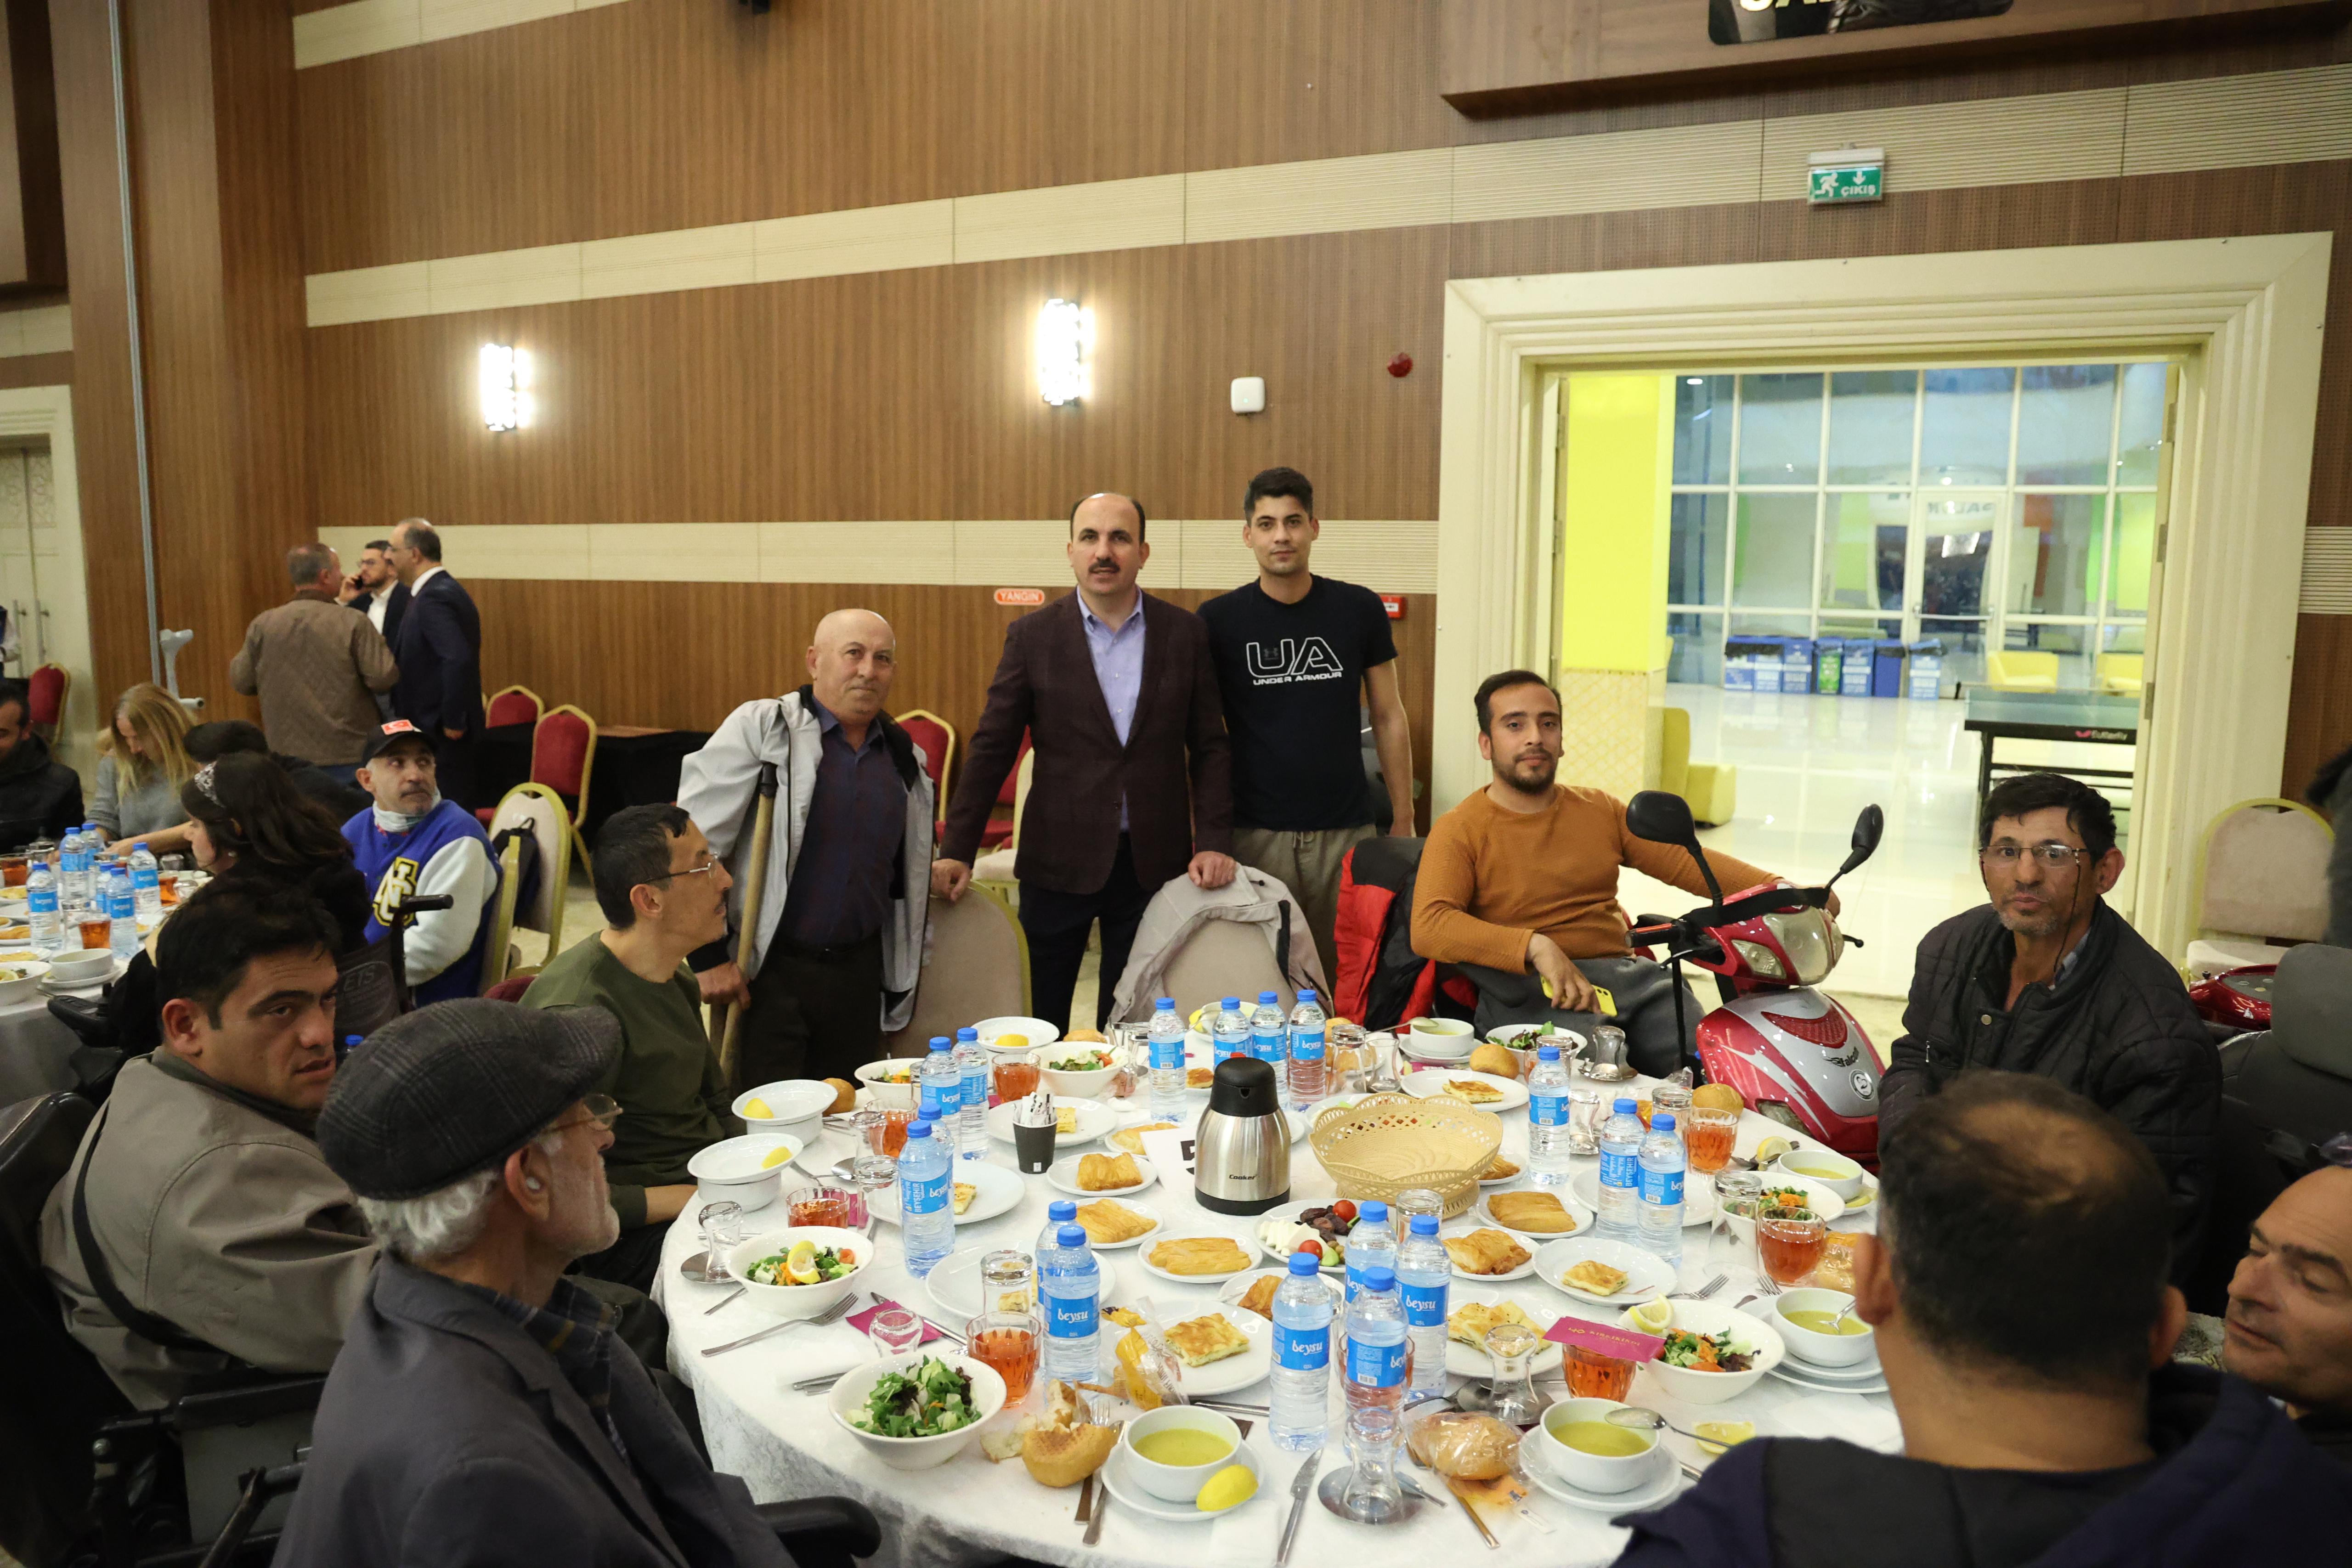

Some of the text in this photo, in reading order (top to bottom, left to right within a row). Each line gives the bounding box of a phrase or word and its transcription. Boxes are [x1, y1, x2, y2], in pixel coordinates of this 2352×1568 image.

[1246, 637, 1343, 678] UA
[1253, 671, 1342, 685] UNDER ARMOUR
[1347, 1275, 1365, 1292] beys
[1406, 1295, 1436, 1311] beysu
[1058, 1308, 1088, 1324] beysu
[1292, 1340, 1323, 1355] beysu
